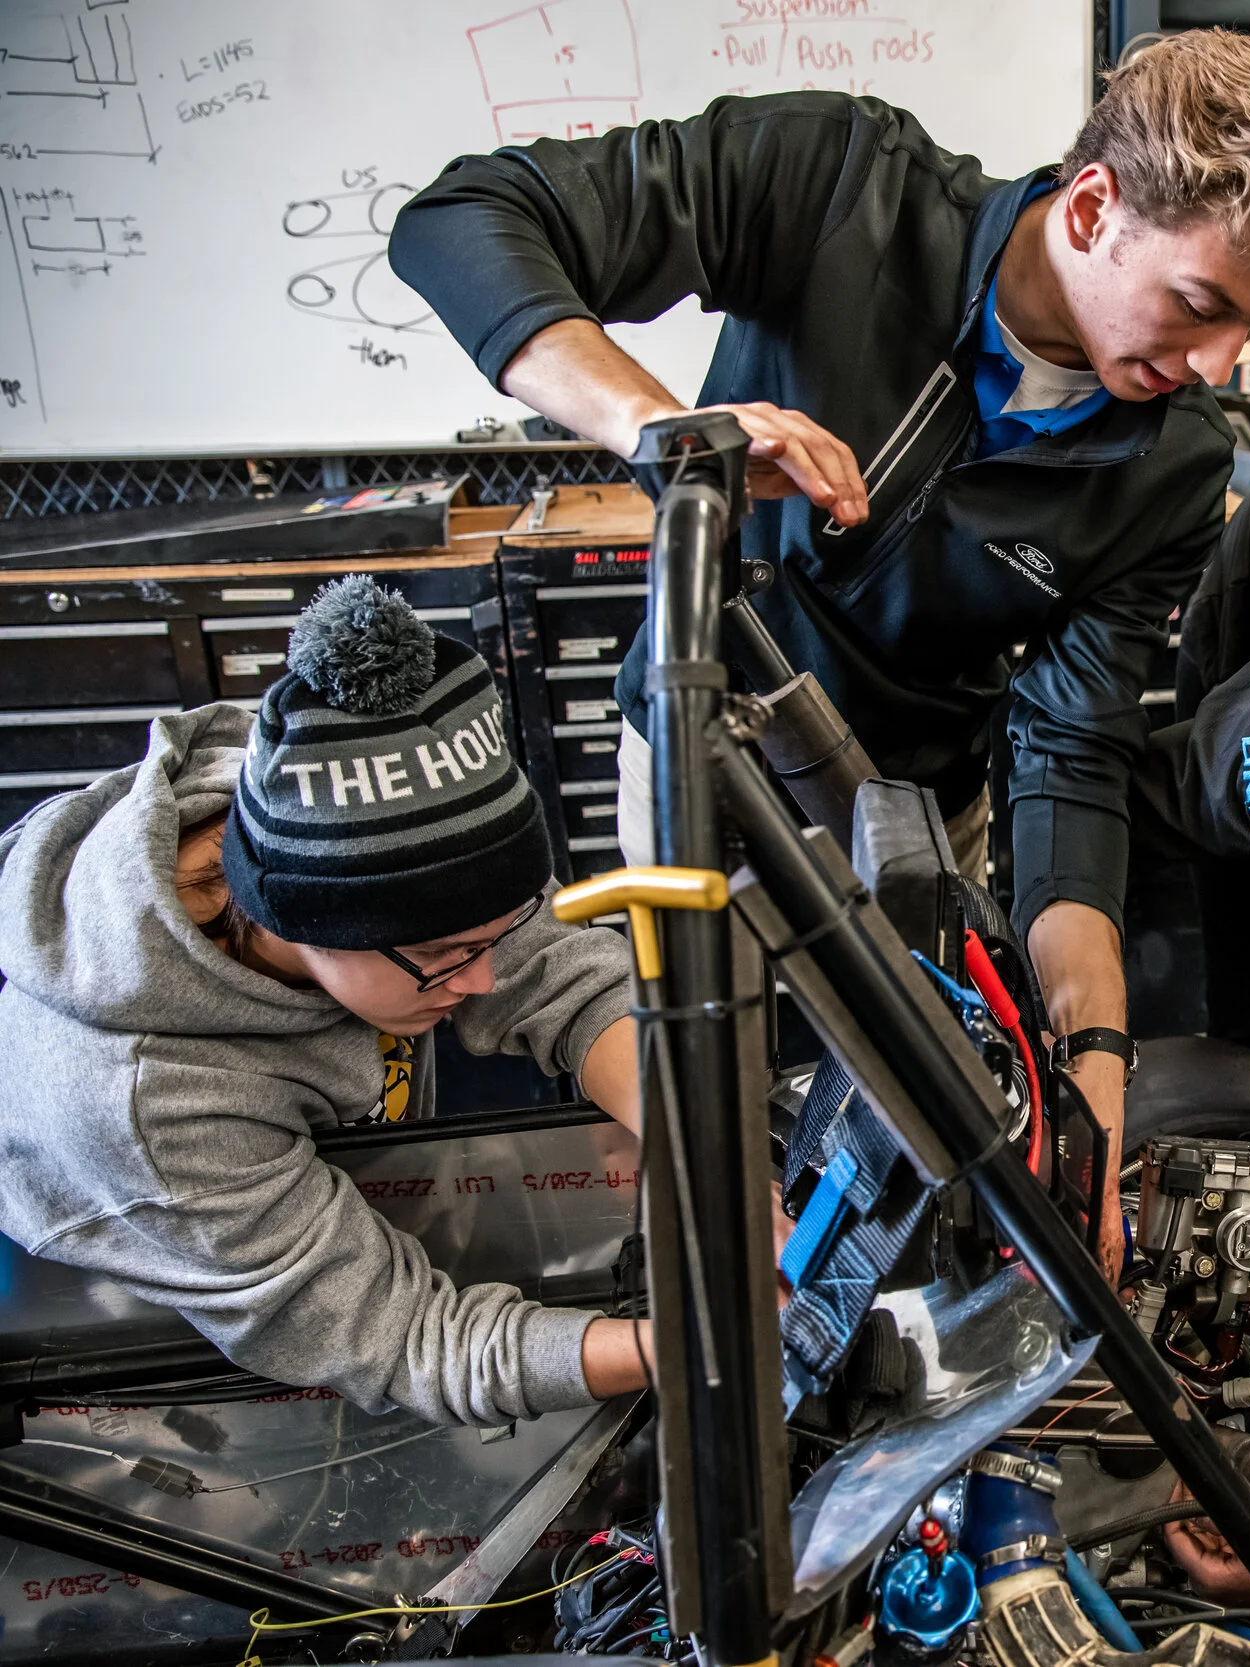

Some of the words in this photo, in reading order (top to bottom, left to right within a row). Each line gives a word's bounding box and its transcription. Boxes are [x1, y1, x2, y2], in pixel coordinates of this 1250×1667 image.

[797, 34, 853, 70] Push
[872, 28, 936, 64] rods
[341, 165, 379, 189] US
[983, 542, 1006, 558] FORD
[1003, 555, 1062, 599] PERFORMANCE
[1020, 548, 1048, 569] Ford
[280, 752, 414, 808] THE
